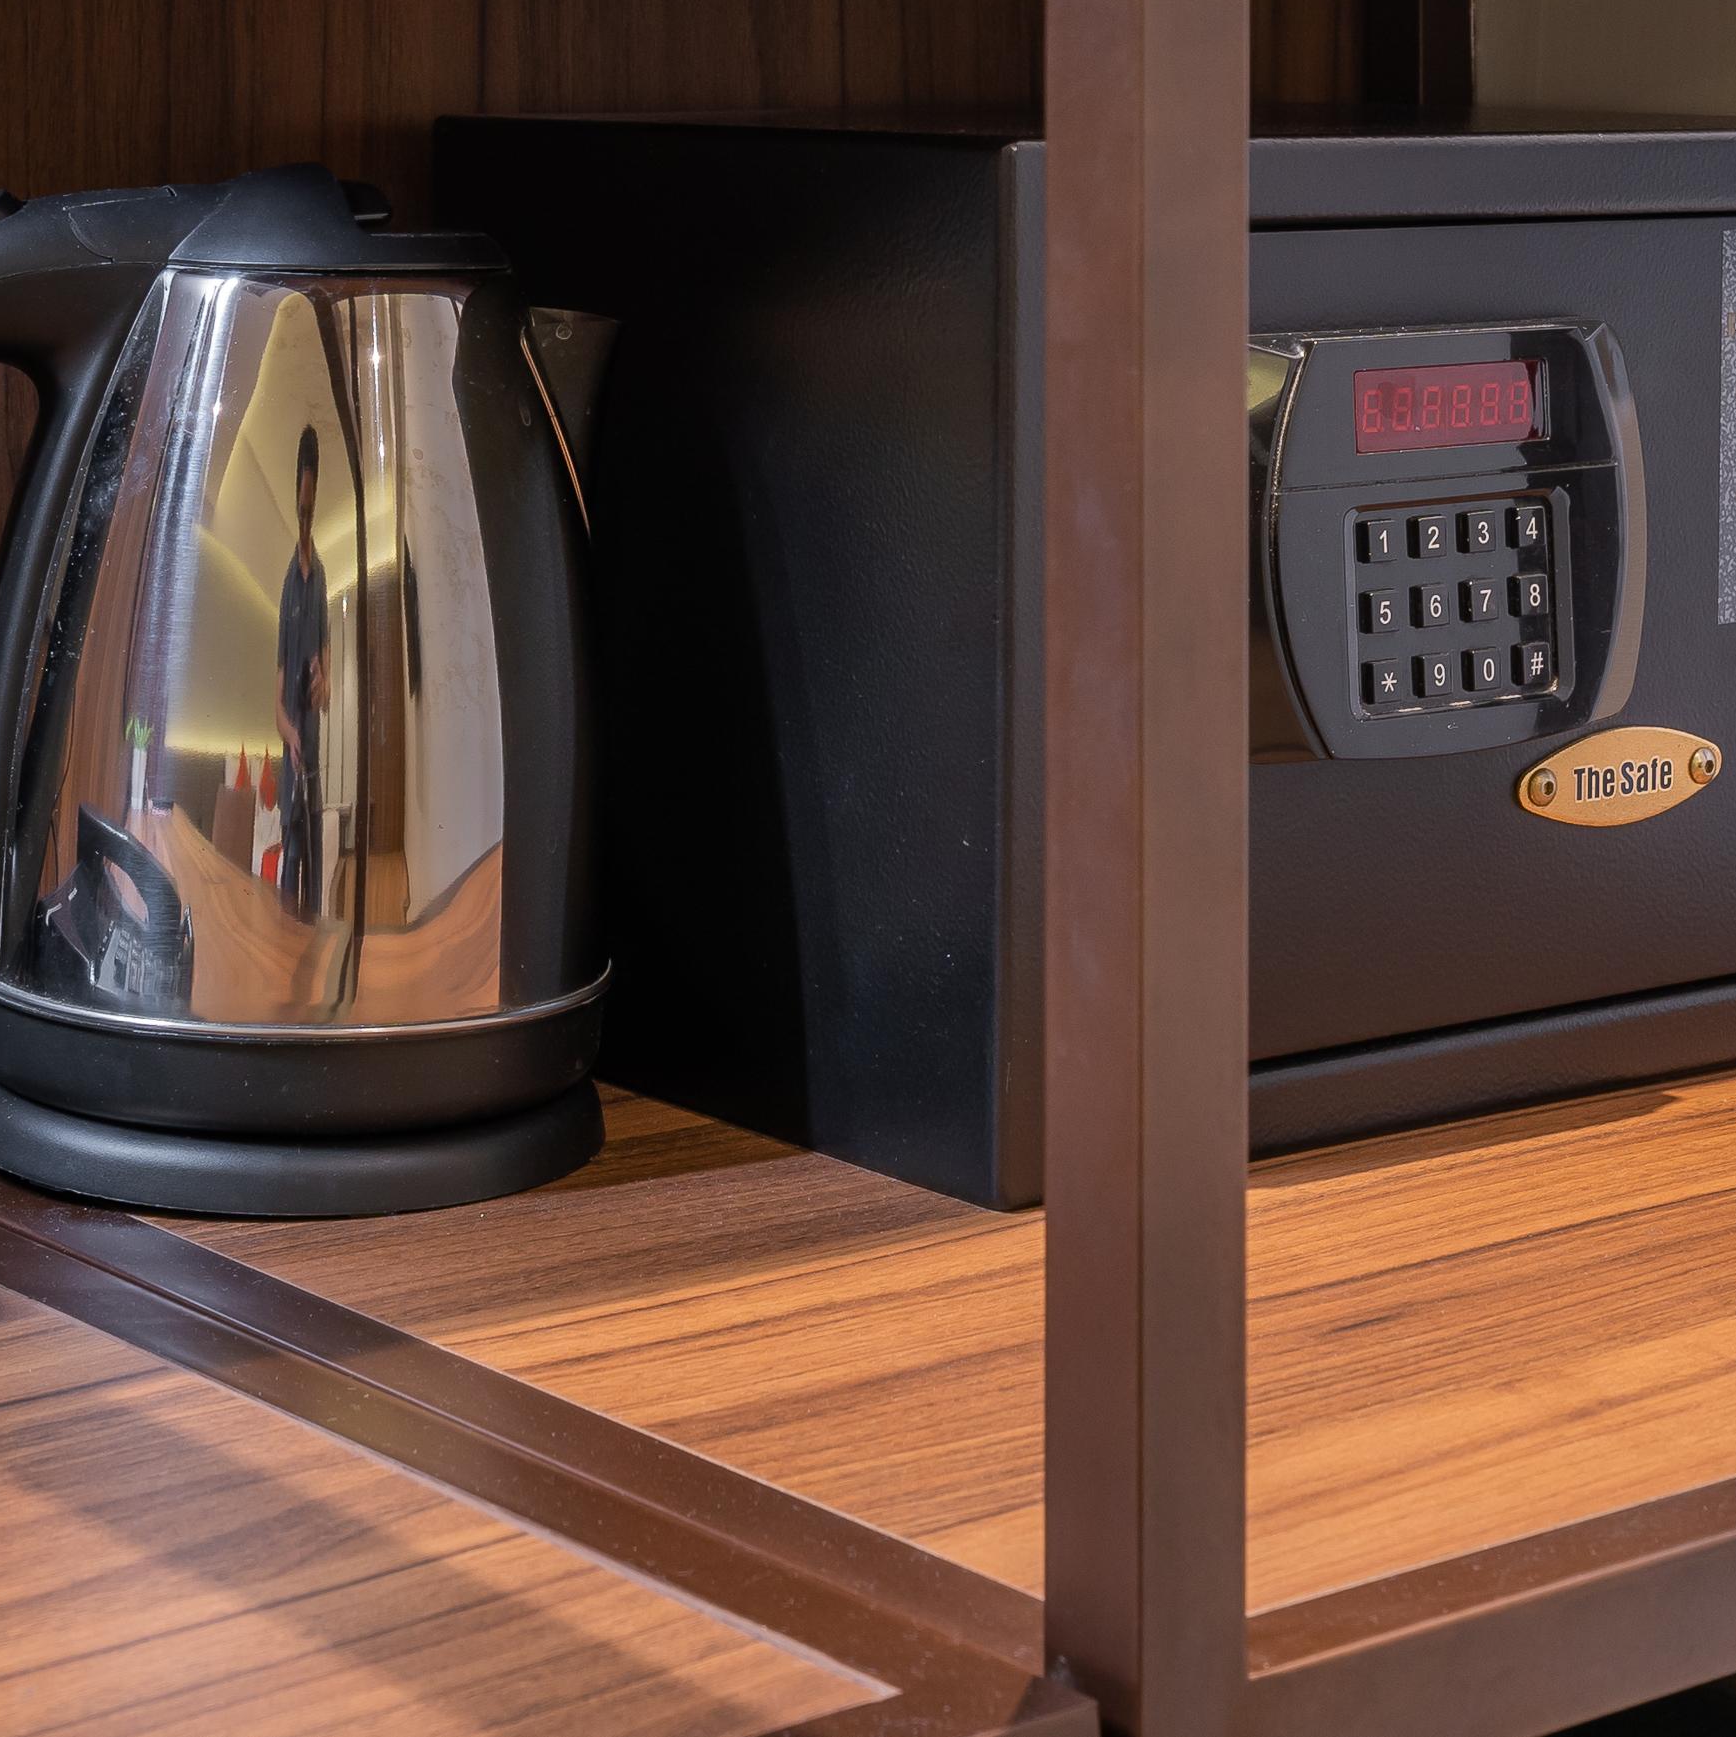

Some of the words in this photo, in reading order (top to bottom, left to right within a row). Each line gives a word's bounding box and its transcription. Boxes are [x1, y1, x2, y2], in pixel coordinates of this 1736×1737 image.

[1379, 530, 1388, 554] 1
[1427, 526, 1440, 549] 2
[1478, 521, 1490, 544] 3
[1525, 517, 1538, 540] 4
[1379, 601, 1392, 625] 5
[1430, 594, 1442, 618] 6
[1480, 589, 1492, 613] 7
[1529, 583, 1541, 607] 8
[1434, 663, 1446, 687] 9
[1483, 658, 1495, 682] 0
[1530, 651, 1544, 675] #
[1573, 767, 1615, 801] The
[1620, 757, 1673, 795] Safe
